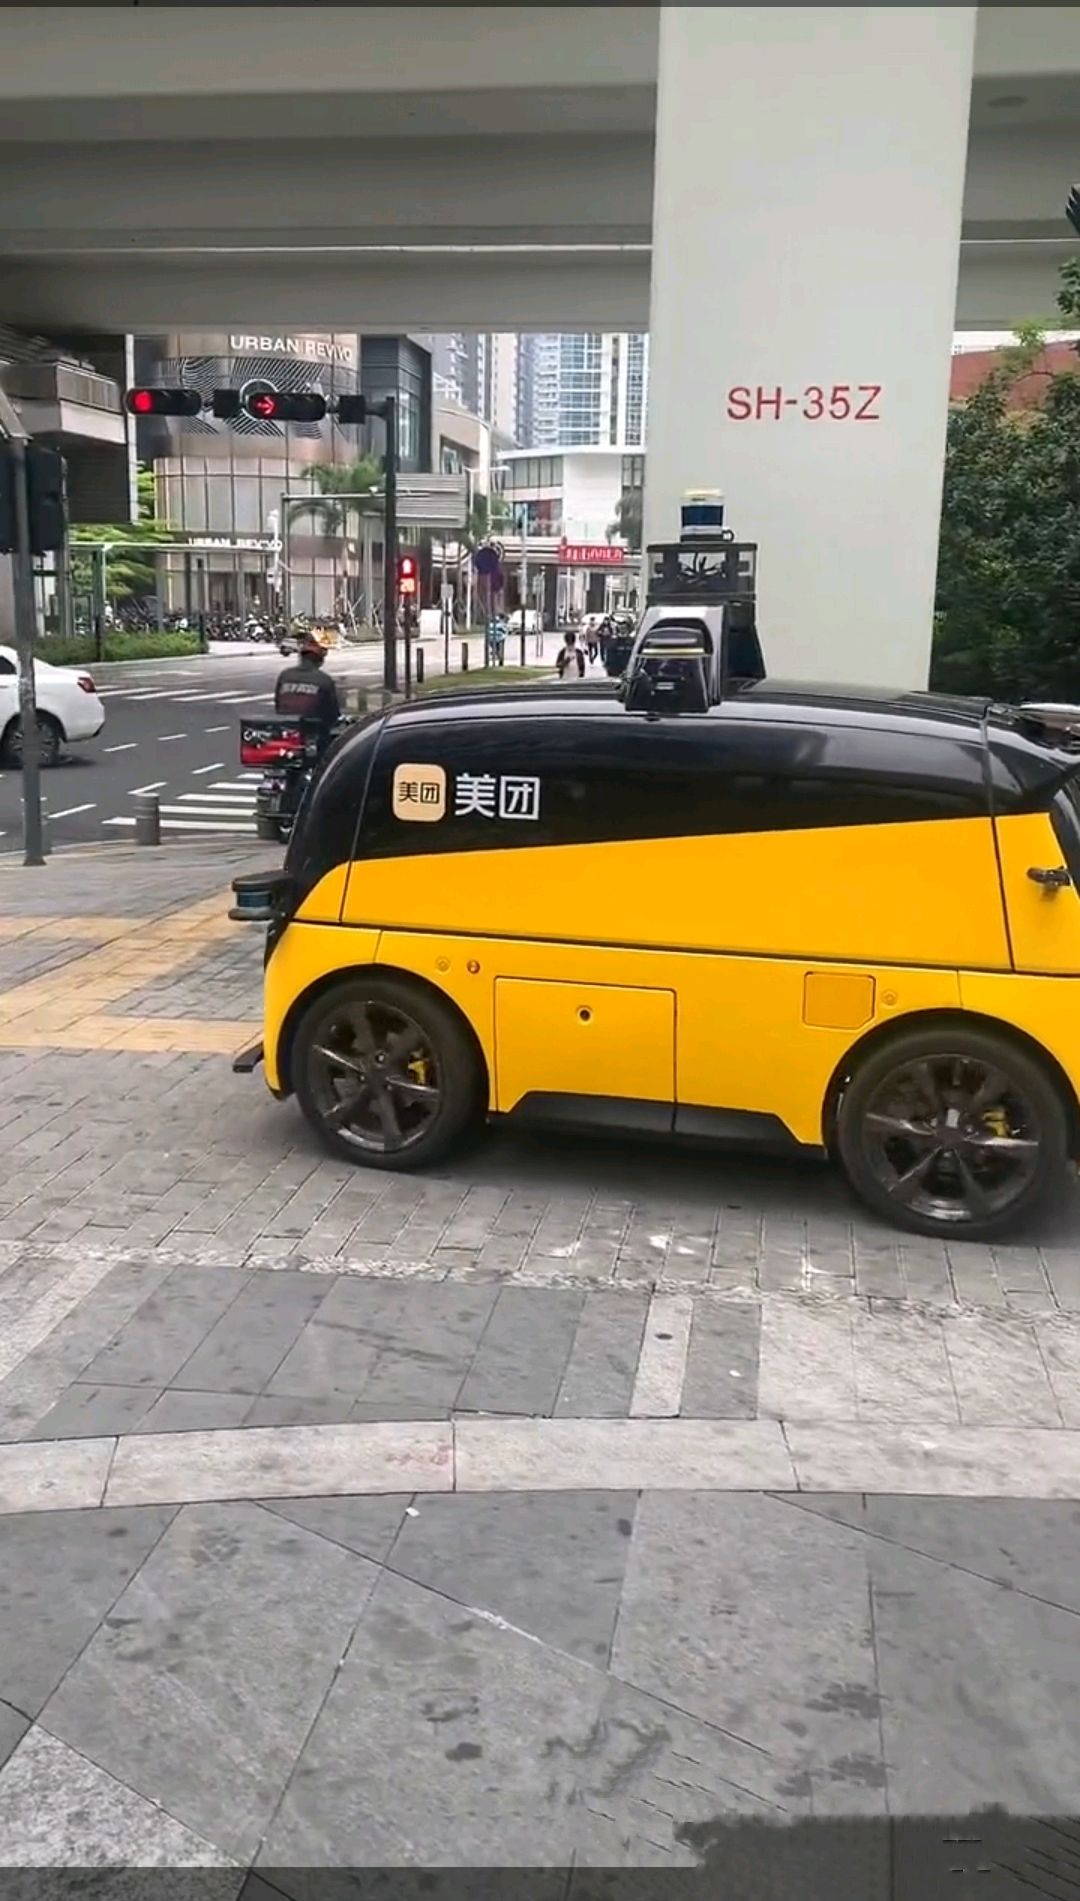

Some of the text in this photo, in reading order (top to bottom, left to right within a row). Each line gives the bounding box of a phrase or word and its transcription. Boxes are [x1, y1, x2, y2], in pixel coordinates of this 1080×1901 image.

[230, 335, 352, 361] URBAN REVIVO
[727, 386, 882, 420] SH-35Z
[398, 772, 541, 820] 美团 美团
